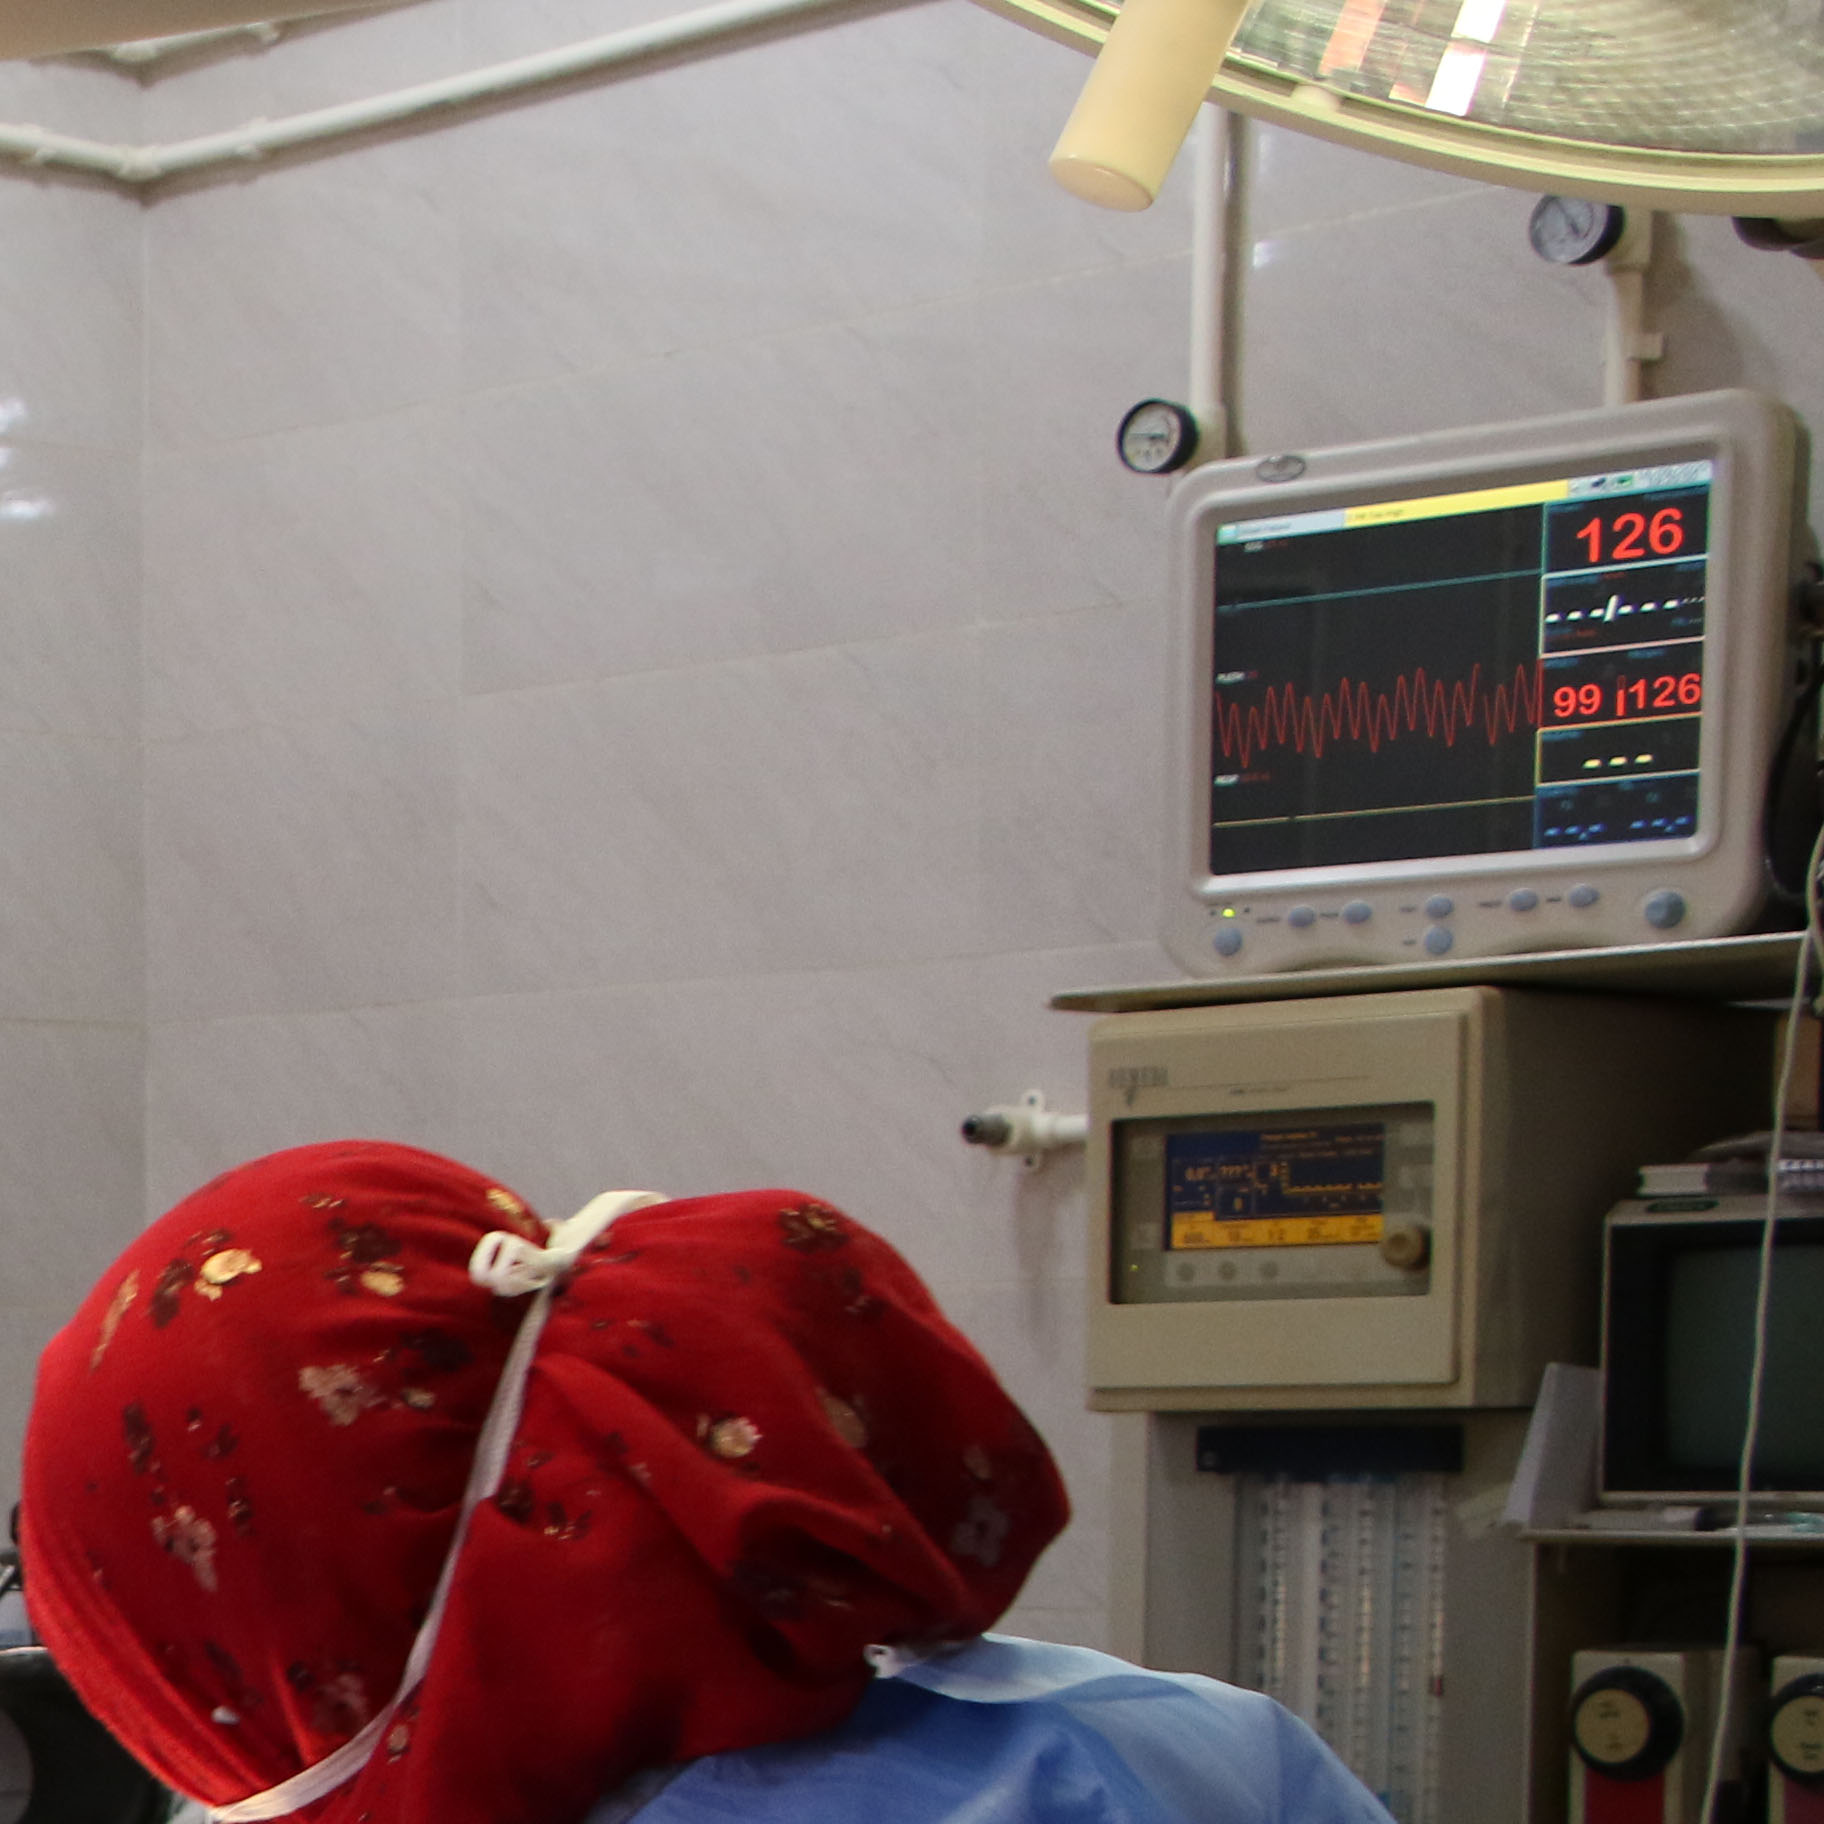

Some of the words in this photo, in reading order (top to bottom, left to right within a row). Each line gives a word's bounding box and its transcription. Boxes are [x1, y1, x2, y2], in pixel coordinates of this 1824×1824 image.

[1576, 507, 1684, 563] 126
[1554, 684, 1603, 717] 99
[1629, 673, 1702, 709] 126
